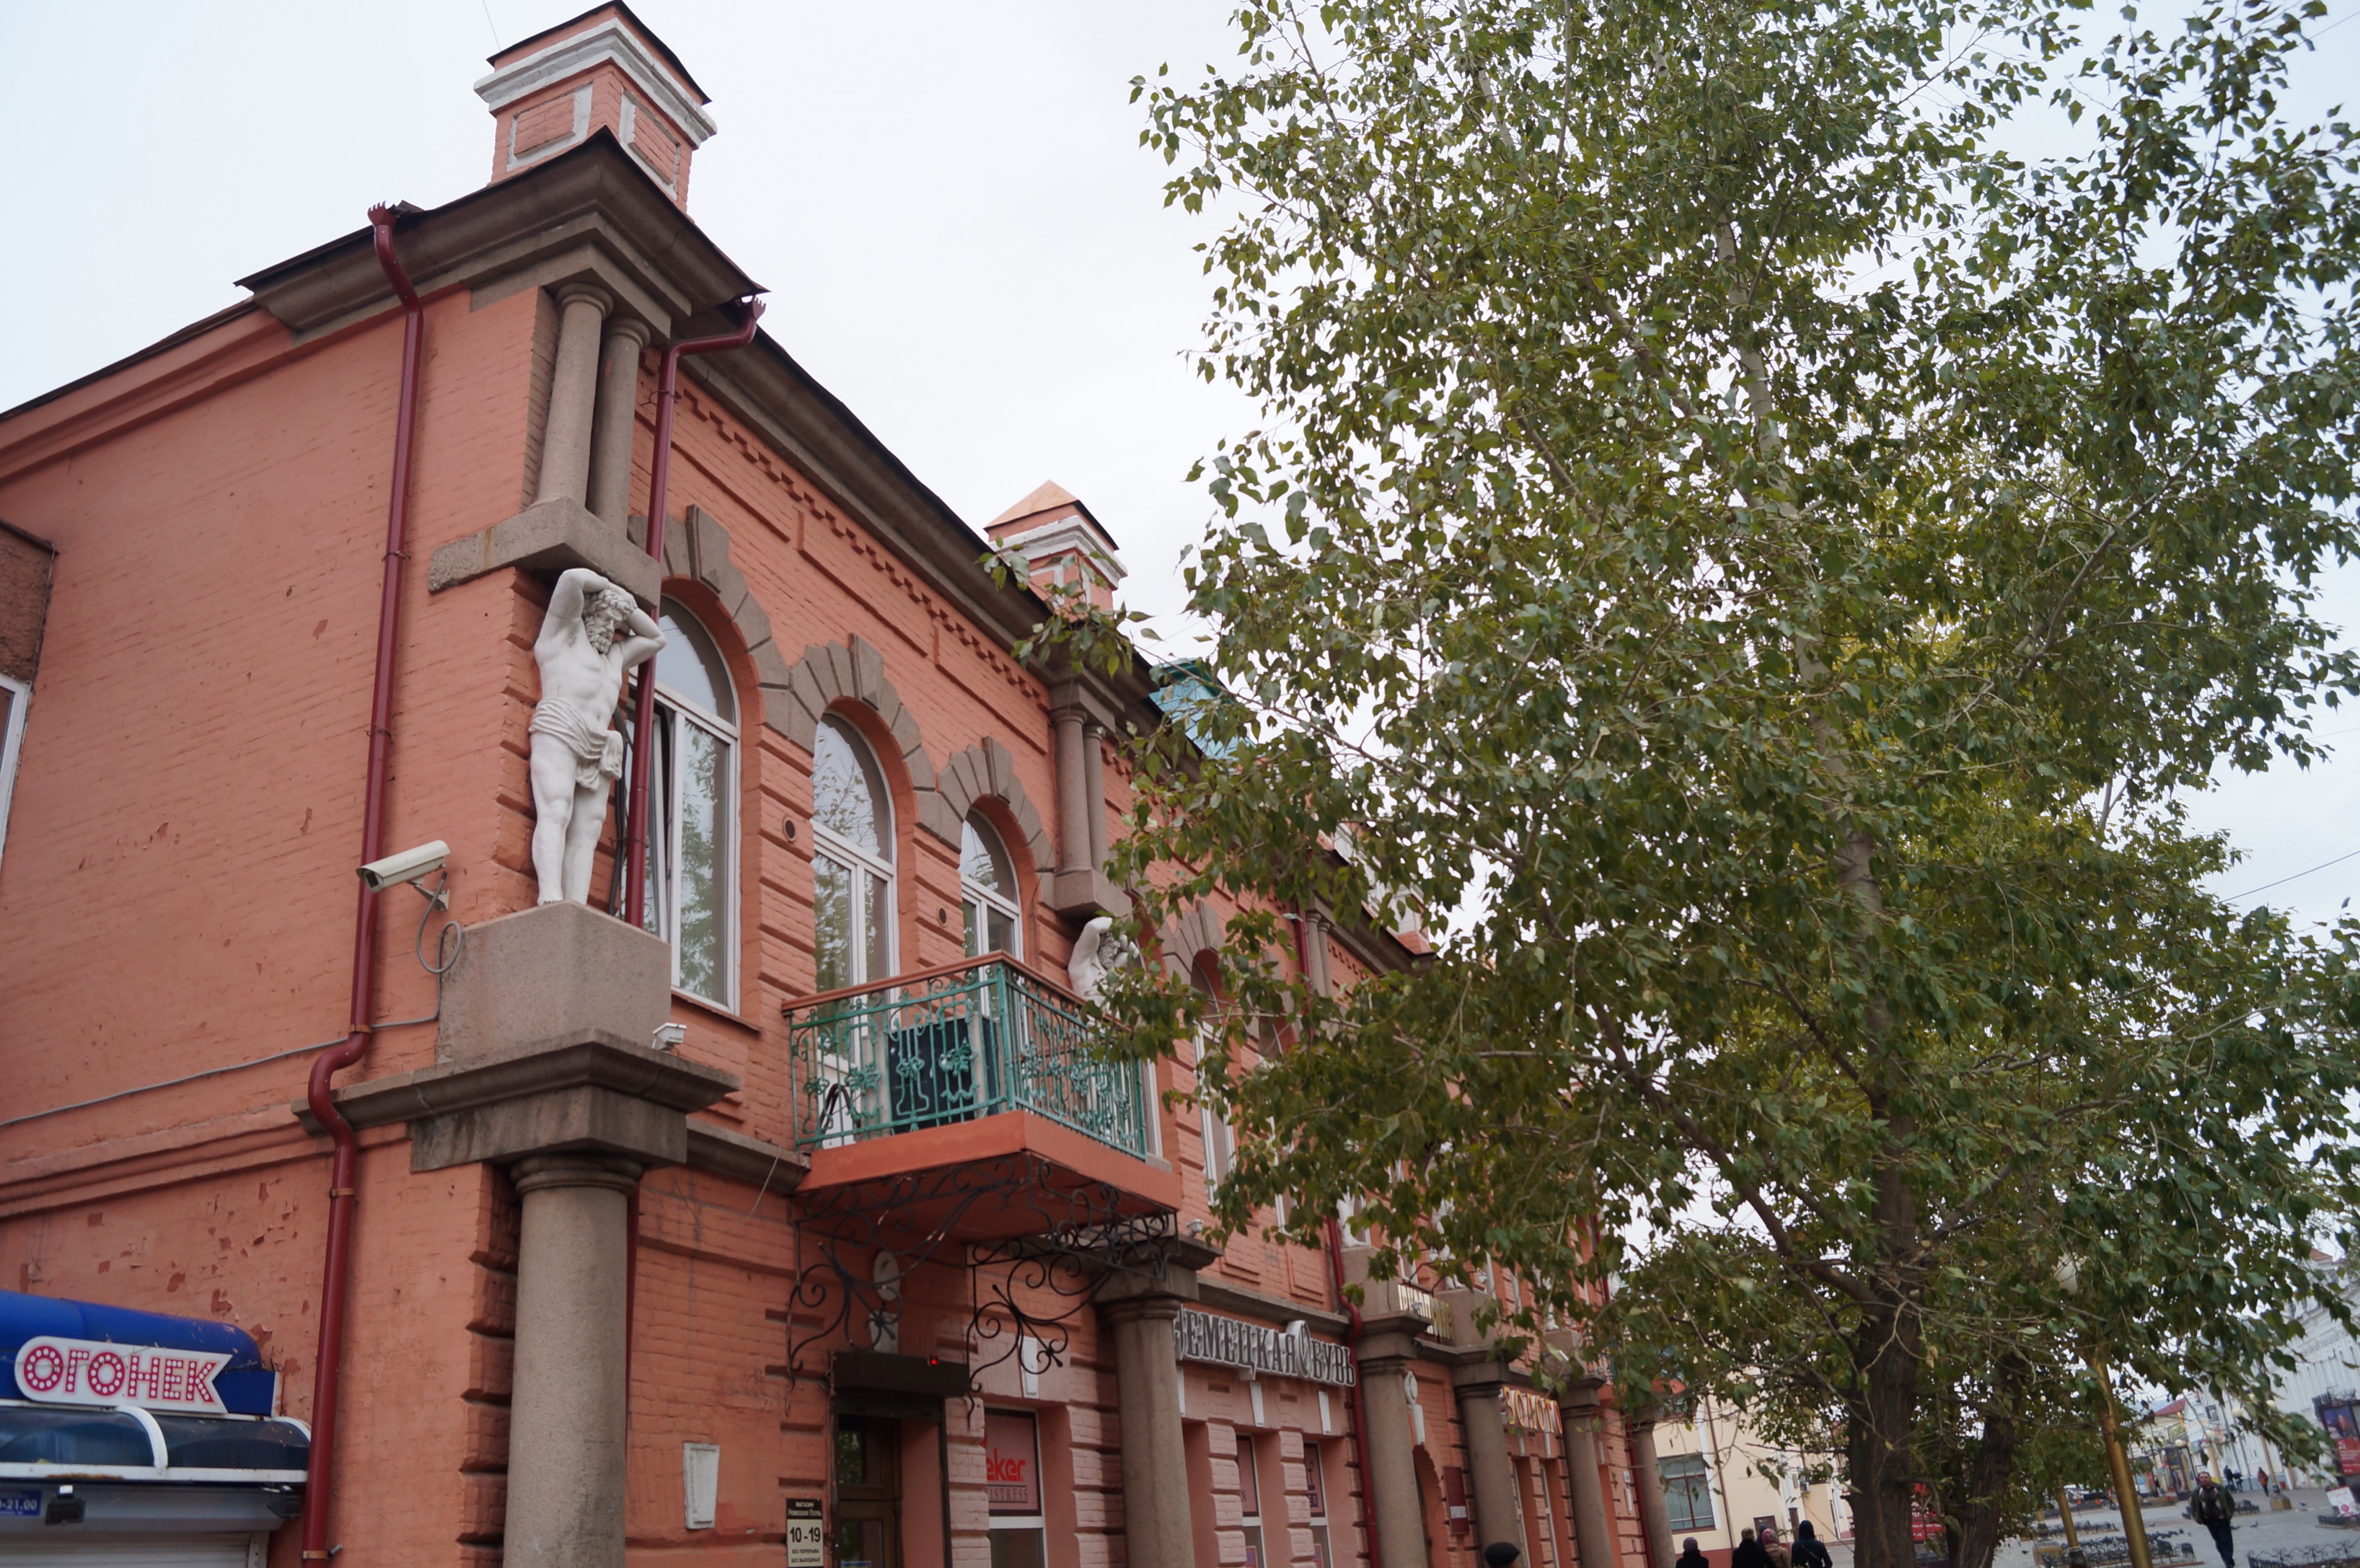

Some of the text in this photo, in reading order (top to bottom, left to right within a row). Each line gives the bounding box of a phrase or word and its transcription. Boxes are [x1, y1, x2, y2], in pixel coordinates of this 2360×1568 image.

[24, 1346, 217, 1403] ОГОНЕК
[1299, 1321, 1356, 1386] ОБУВЬ
[1503, 1386, 1563, 1435] ЗОЛОТО
[986, 1448, 1025, 1481] eker
[0, 1498, 37, 1511] -21.00
